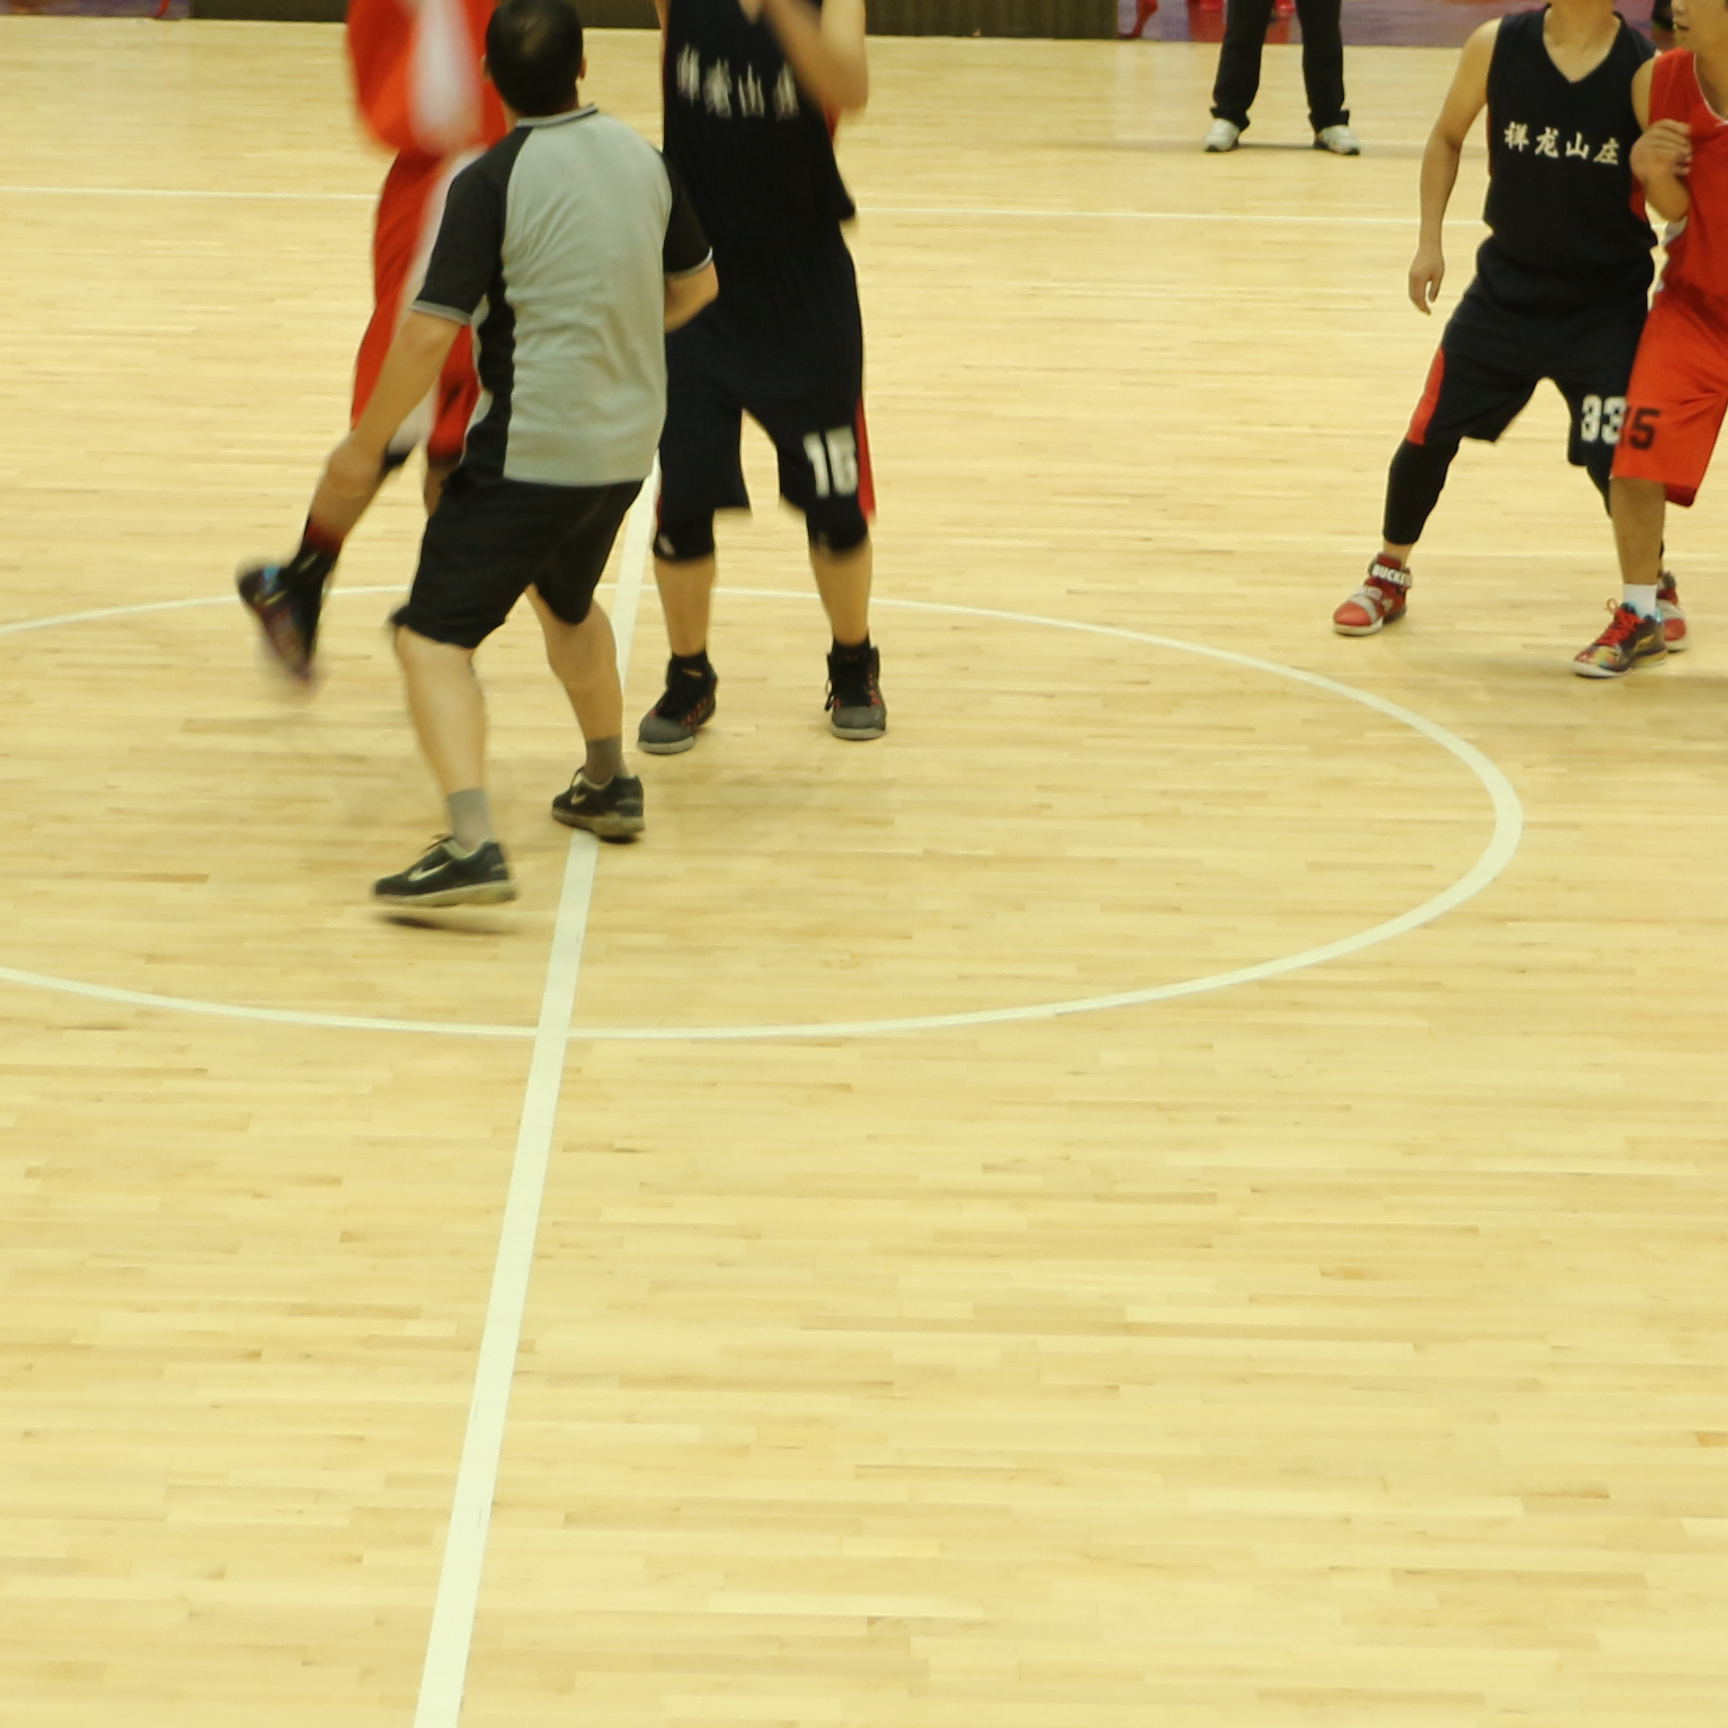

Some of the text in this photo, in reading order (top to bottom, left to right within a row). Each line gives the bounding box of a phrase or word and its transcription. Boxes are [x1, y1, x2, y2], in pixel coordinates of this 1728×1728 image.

[1504, 121, 1619, 165] 祥龙山庄
[1581, 393, 1627, 444] 33
